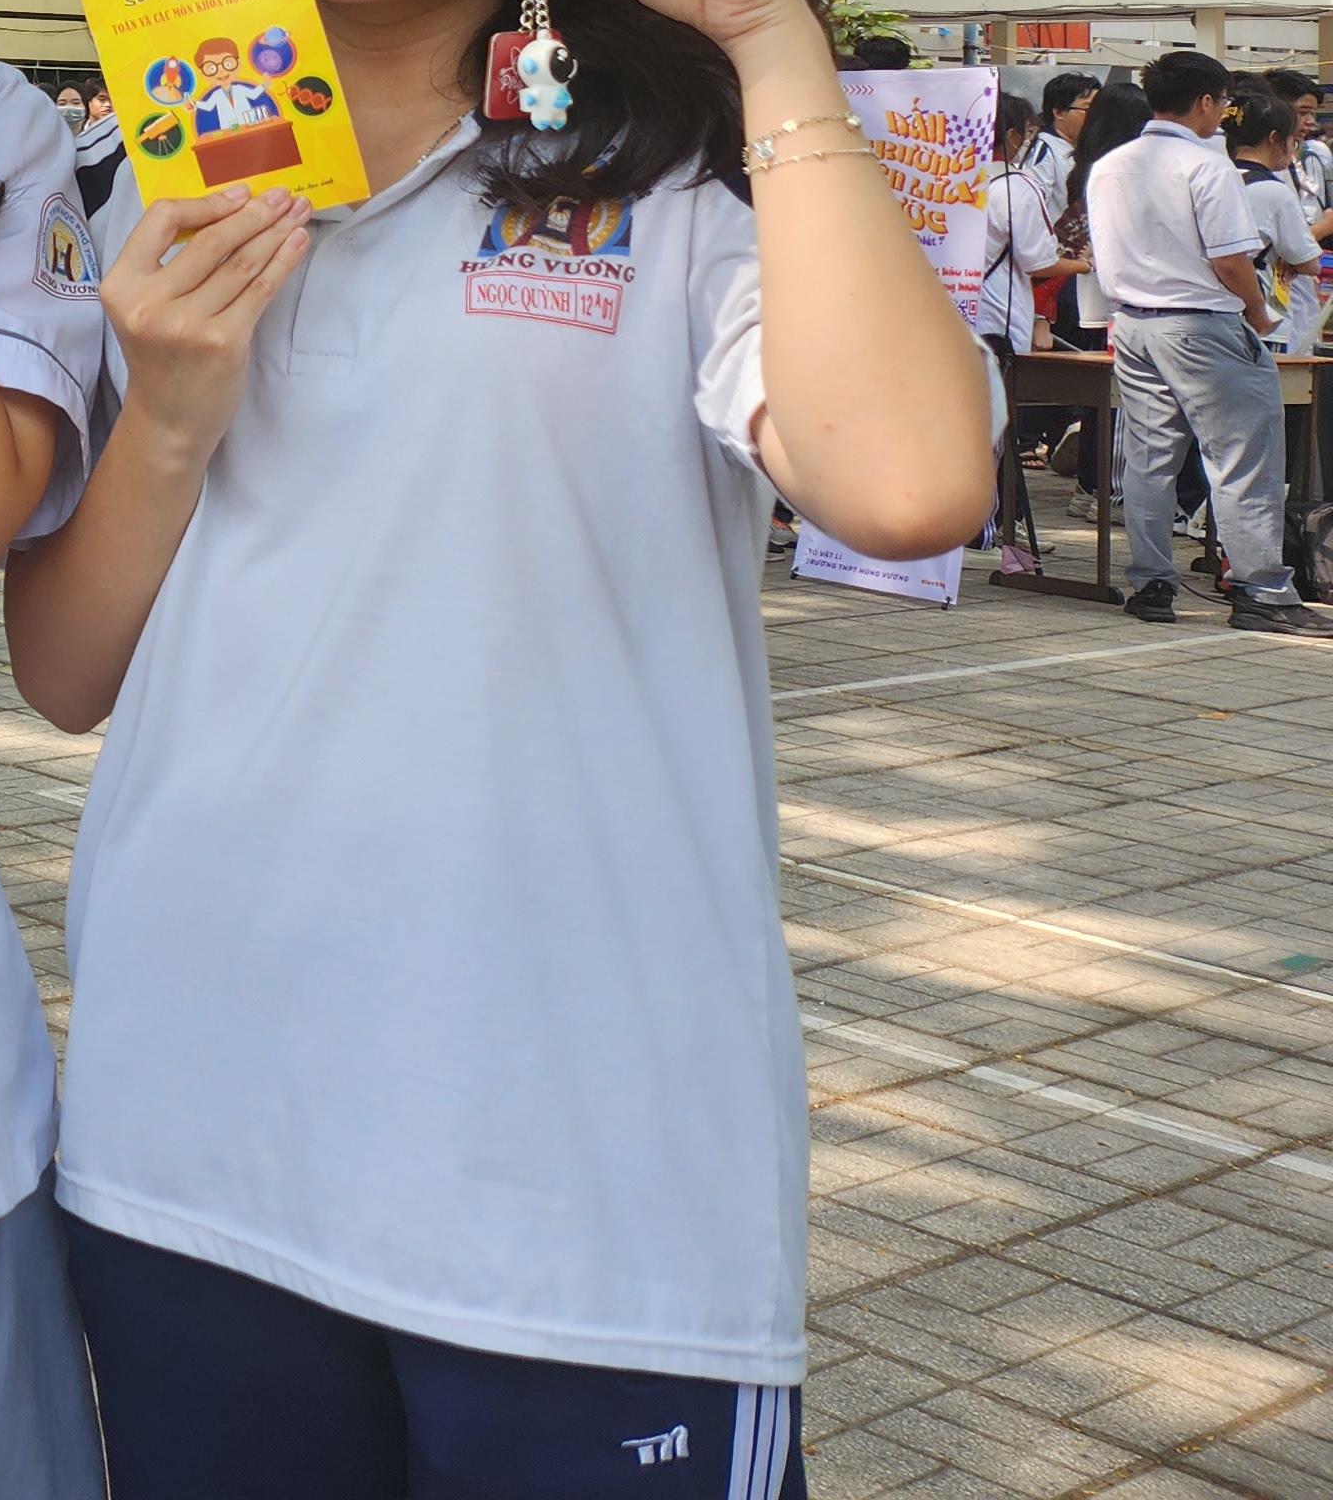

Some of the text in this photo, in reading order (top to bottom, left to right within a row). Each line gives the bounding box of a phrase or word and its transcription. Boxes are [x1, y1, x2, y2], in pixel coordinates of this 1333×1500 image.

[543, 258, 635, 283] VƯƠNG
[60, 283, 99, 295] VƯƠN
[477, 283, 518, 308] NGỌC
[521, 284, 571, 313] QUỲNH
